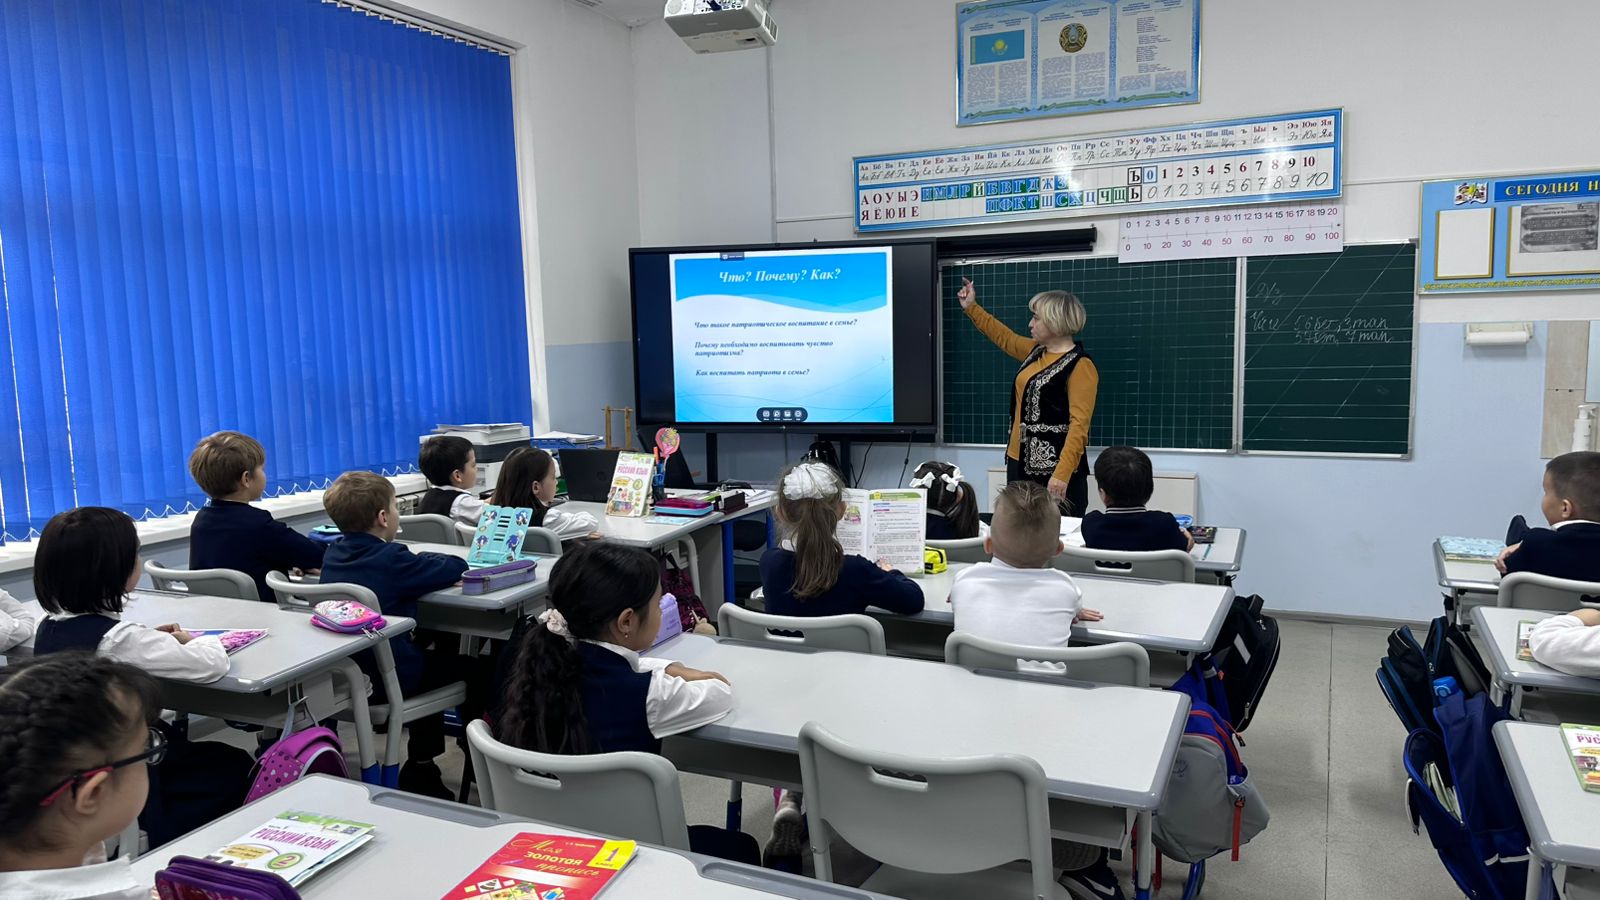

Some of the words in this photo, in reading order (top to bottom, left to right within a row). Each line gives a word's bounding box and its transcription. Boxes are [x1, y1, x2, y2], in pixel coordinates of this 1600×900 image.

[1302, 120, 1317, 128] Юю
[1147, 170, 1154, 180] 0
[1162, 169, 1167, 179] 1
[1177, 167, 1184, 178] 2
[1192, 166, 1200, 177] 3
[1207, 165, 1214, 175] 4
[1223, 163, 1231, 174] 5
[1240, 162, 1247, 173] 6
[1256, 160, 1263, 171] 7
[1272, 159, 1279, 170] 8
[1288, 157, 1296, 168] 9
[1303, 156, 1315, 167] 10
[861, 195, 869, 206] А
[873, 193, 882, 204] О
[885, 192, 894, 203] У
[898, 191, 907, 202] Ы
[910, 190, 919, 201] Э
[961, 184, 971, 198] Р
[975, 182, 983, 196] Й
[987, 182, 998, 195] Б
[1000, 181, 1012, 194] В
[1014, 180, 1025, 192] Г
[1028, 178, 1040, 192] Д
[1042, 177, 1053, 190] Ж
[1130, 170, 1140, 182] Ъ
[1148, 186, 1158, 199] 0
[1164, 184, 1173, 198] 1
[1179, 183, 1188, 197] 2
[1194, 182, 1203, 196] 3
[1210, 181, 1219, 194] 4
[1225, 179, 1236, 193] 5
[1240, 178, 1251, 192] 6
[1258, 177, 1267, 190] 7
[1273, 175, 1283, 189] 8
[1289, 174, 1300, 188] 9
[1307, 171, 1329, 187] 10
[1505, 181, 1579, 196] СЕГОДНЯ
[861, 210, 869, 221] Я
[874, 207, 882, 220] Ё
[885, 208, 895, 219] Ю
[898, 207, 906, 218] И
[911, 206, 920, 218] Е
[987, 199, 998, 213] П
[1000, 198, 1012, 211] Ф
[1014, 197, 1026, 210] К
[1028, 195, 1039, 208] Т
[1042, 195, 1053, 207] Ш
[1056, 193, 1068, 207] С
[1069, 192, 1083, 206] Х
[1086, 192, 1096, 204] Ц
[1101, 190, 1110, 202] Ч
[1114, 189, 1125, 201] Щ
[1131, 188, 1139, 199] Ь
[1223, 214, 1231, 222] 10
[1254, 212, 1262, 220] 13
[1285, 210, 1294, 218] 16
[1307, 209, 1315, 217] 18
[1316, 208, 1326, 216] 19
[1144, 242, 1152, 250] 10
[1161, 241, 1172, 249] 20
[1221, 237, 1232, 245] 50
[1242, 236, 1253, 244] 60
[1263, 235, 1273, 243] 70
[1283, 234, 1294, 242] 80
[1305, 233, 1316, 241] 90
[1325, 232, 1339, 240] 100
[719, 271, 752, 283] Что?
[755, 269, 808, 283] Почему?
[810, 268, 841, 280] Как?
[835, 318, 858, 326] семье?
[695, 341, 719, 349] Почему
[250, 828, 306, 844] РУССКИЙ
[298, 835, 339, 851] ЯЗЫК
[524, 851, 583, 866] золотая
[606, 847, 620, 862] 1
[536, 863, 600, 876] пропись
